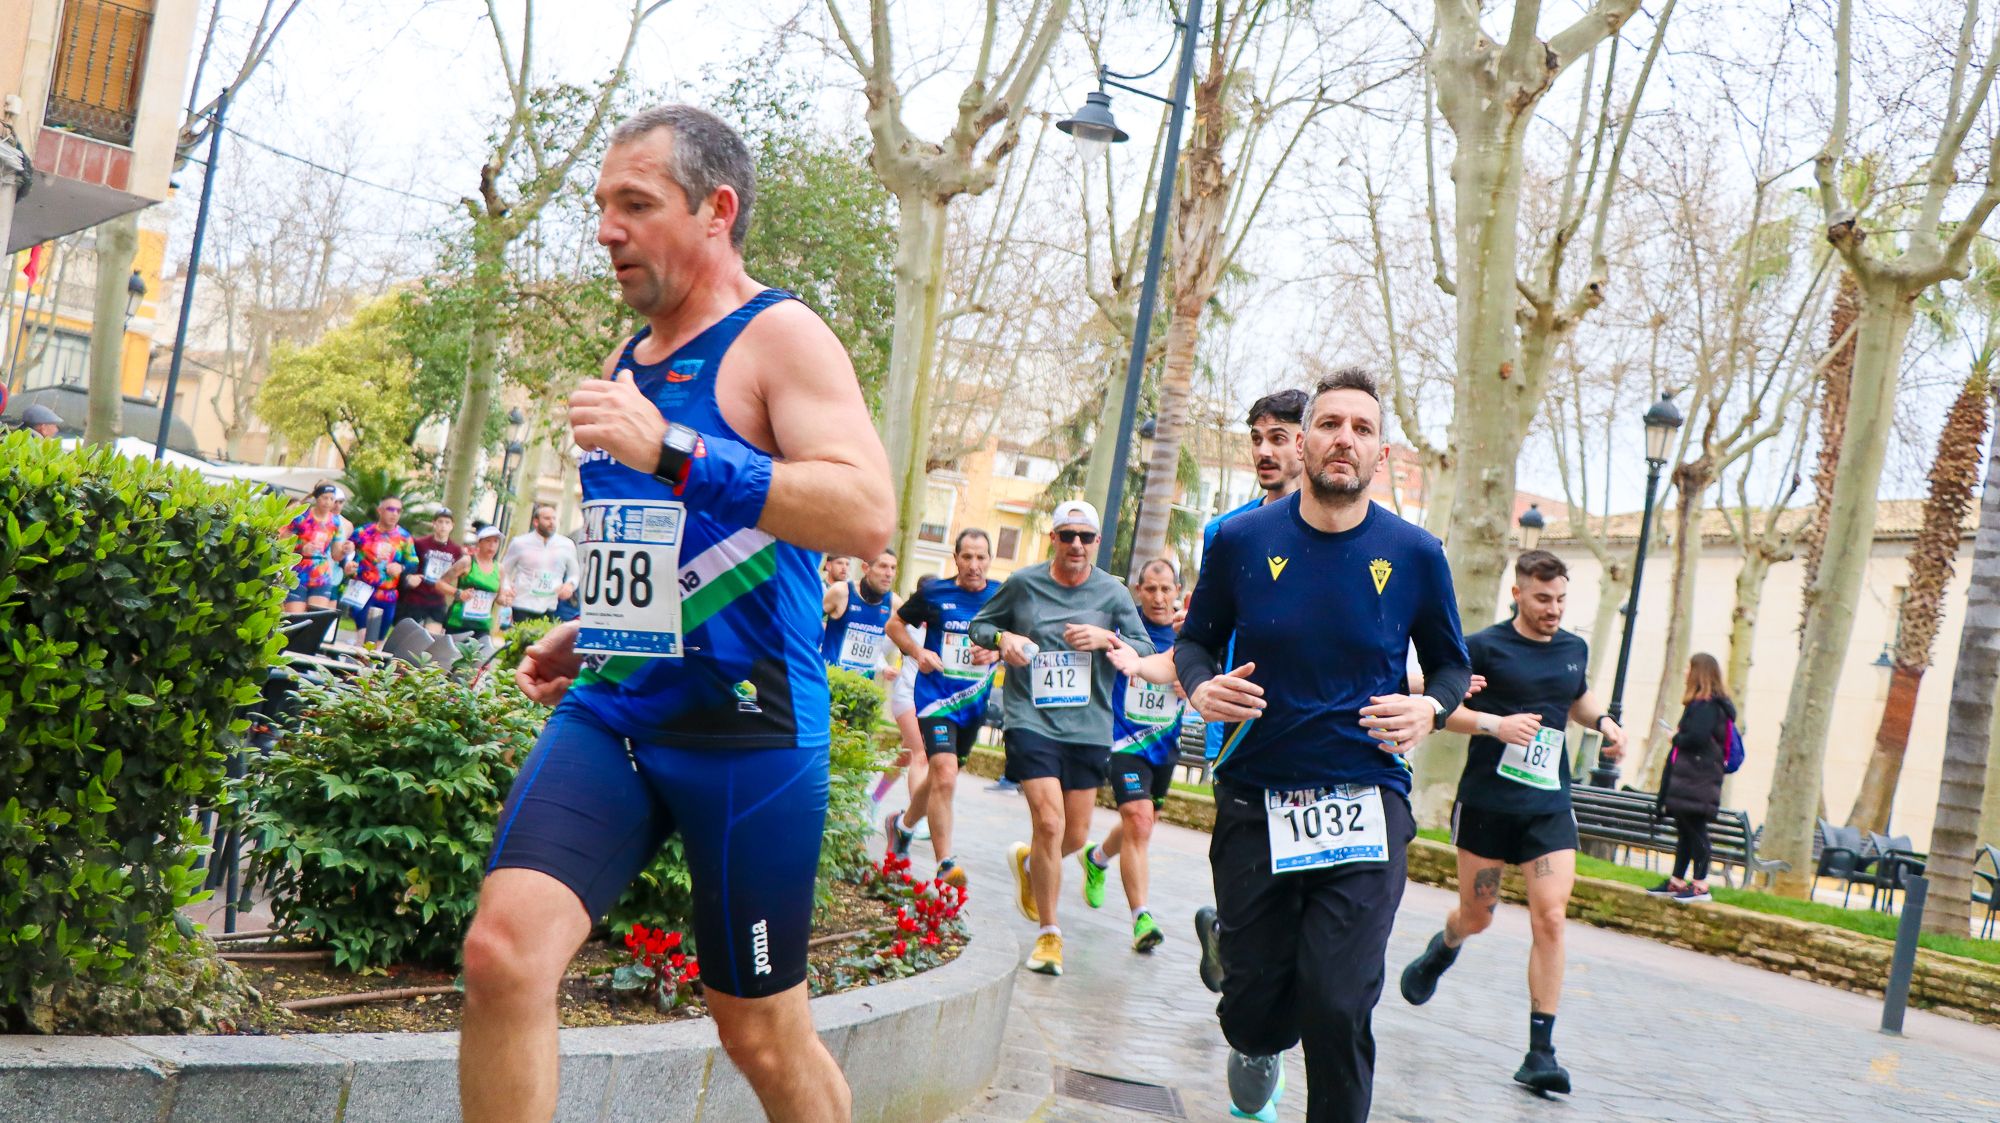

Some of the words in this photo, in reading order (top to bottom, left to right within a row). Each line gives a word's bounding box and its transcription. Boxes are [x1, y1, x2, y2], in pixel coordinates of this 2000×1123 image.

[585, 549, 653, 608] 058
[851, 642, 874, 659] 899
[955, 648, 971, 665] 18
[1044, 668, 1076, 688] 412
[1138, 692, 1165, 710] 184
[1523, 745, 1551, 768] 182
[1284, 803, 1364, 842] 1032
